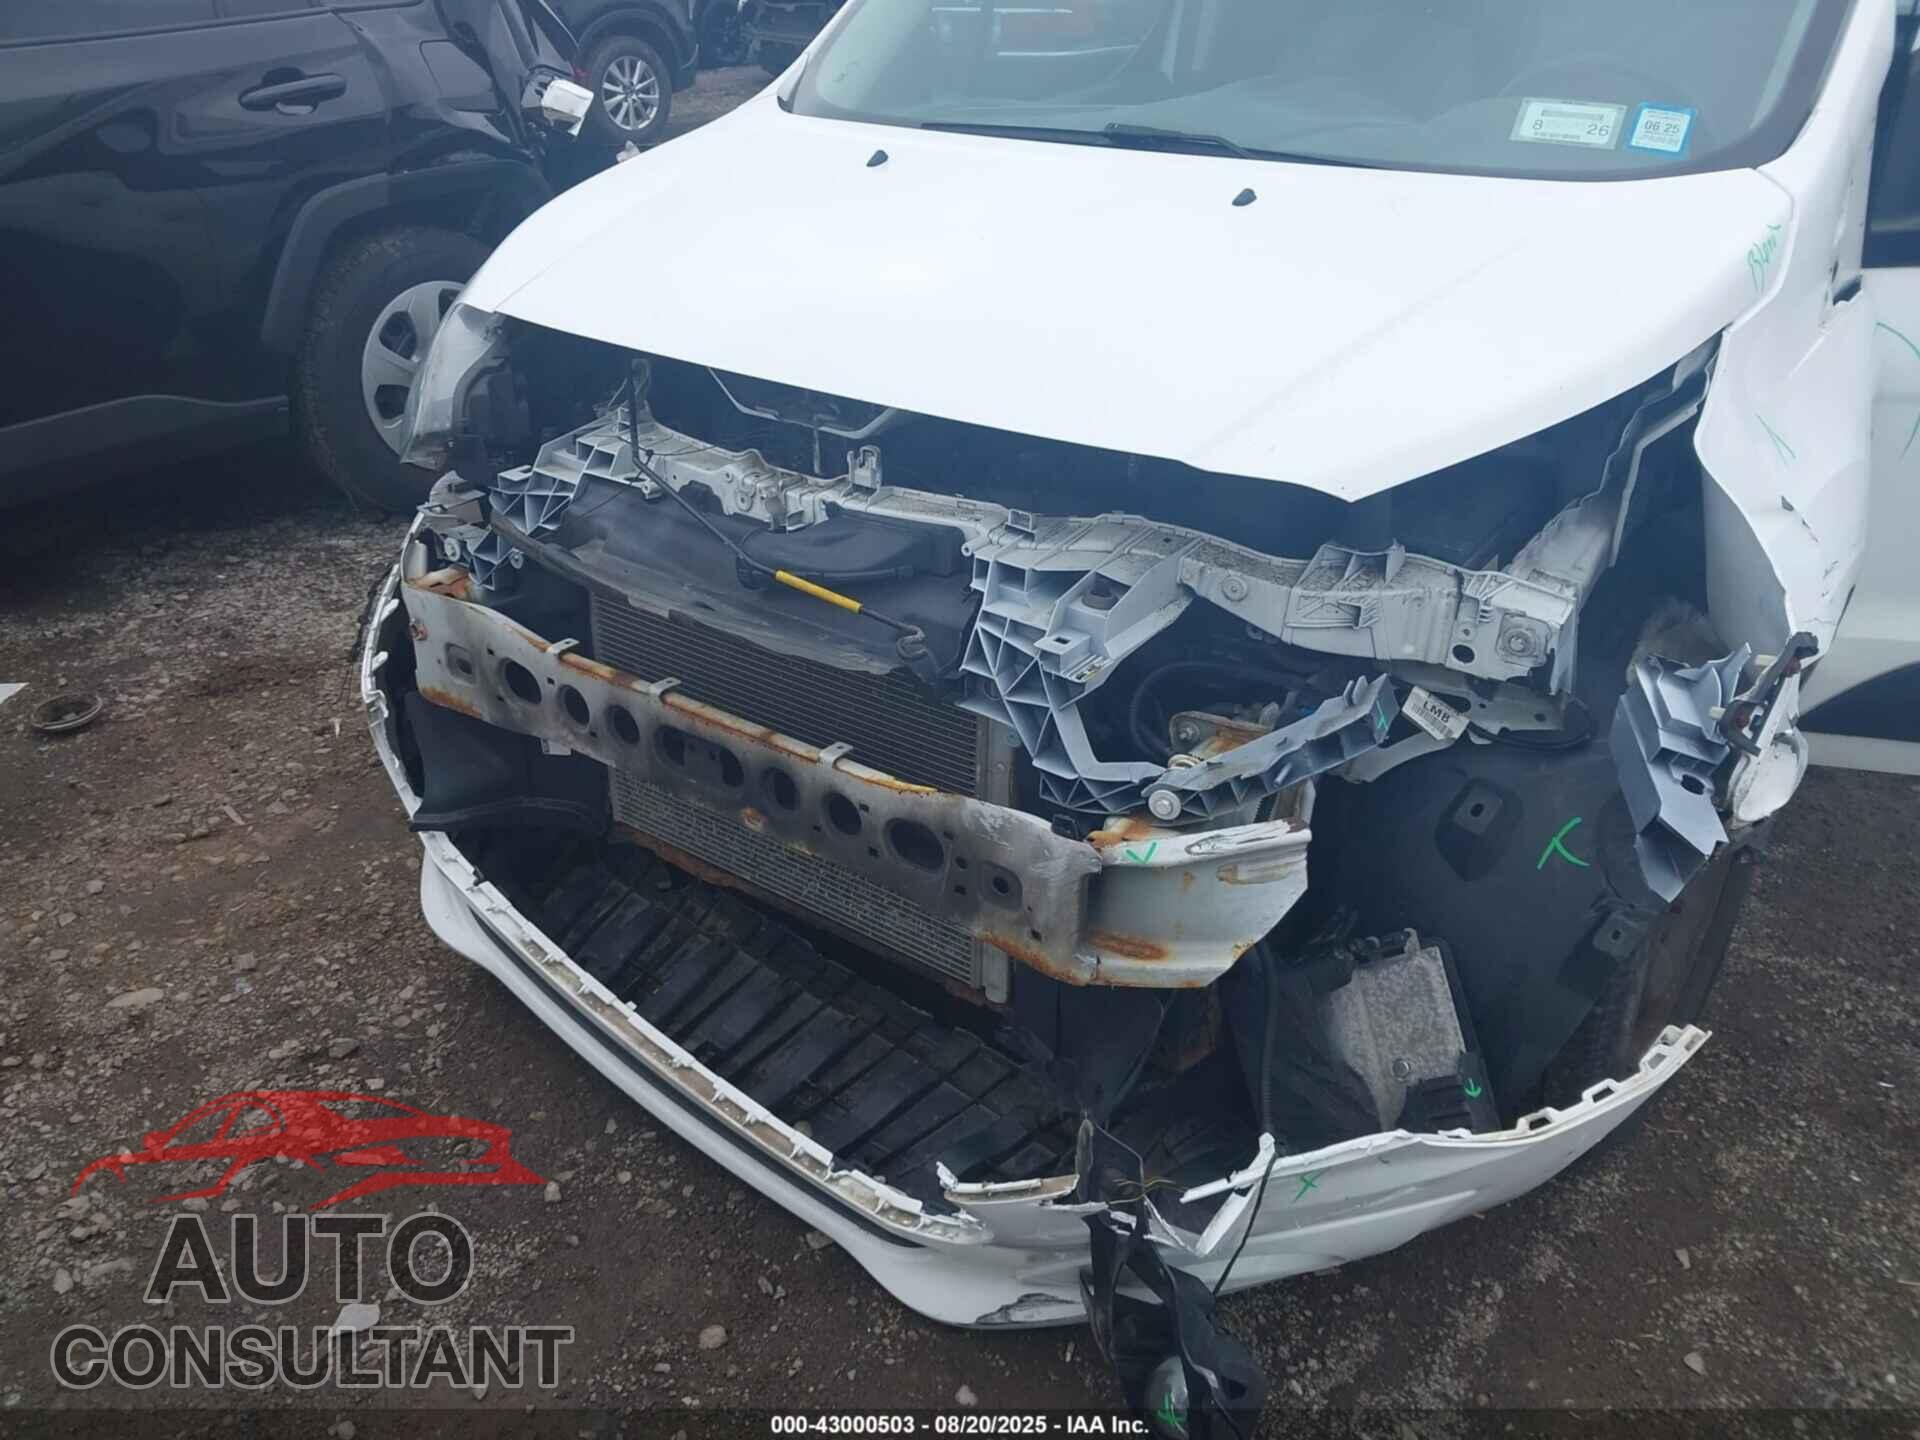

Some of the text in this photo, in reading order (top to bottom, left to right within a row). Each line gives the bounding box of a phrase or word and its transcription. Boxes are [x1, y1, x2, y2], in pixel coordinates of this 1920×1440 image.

[1531, 119, 1543, 131] 8
[1586, 123, 1610, 137] 26
[1644, 119, 1680, 134] 06 25
